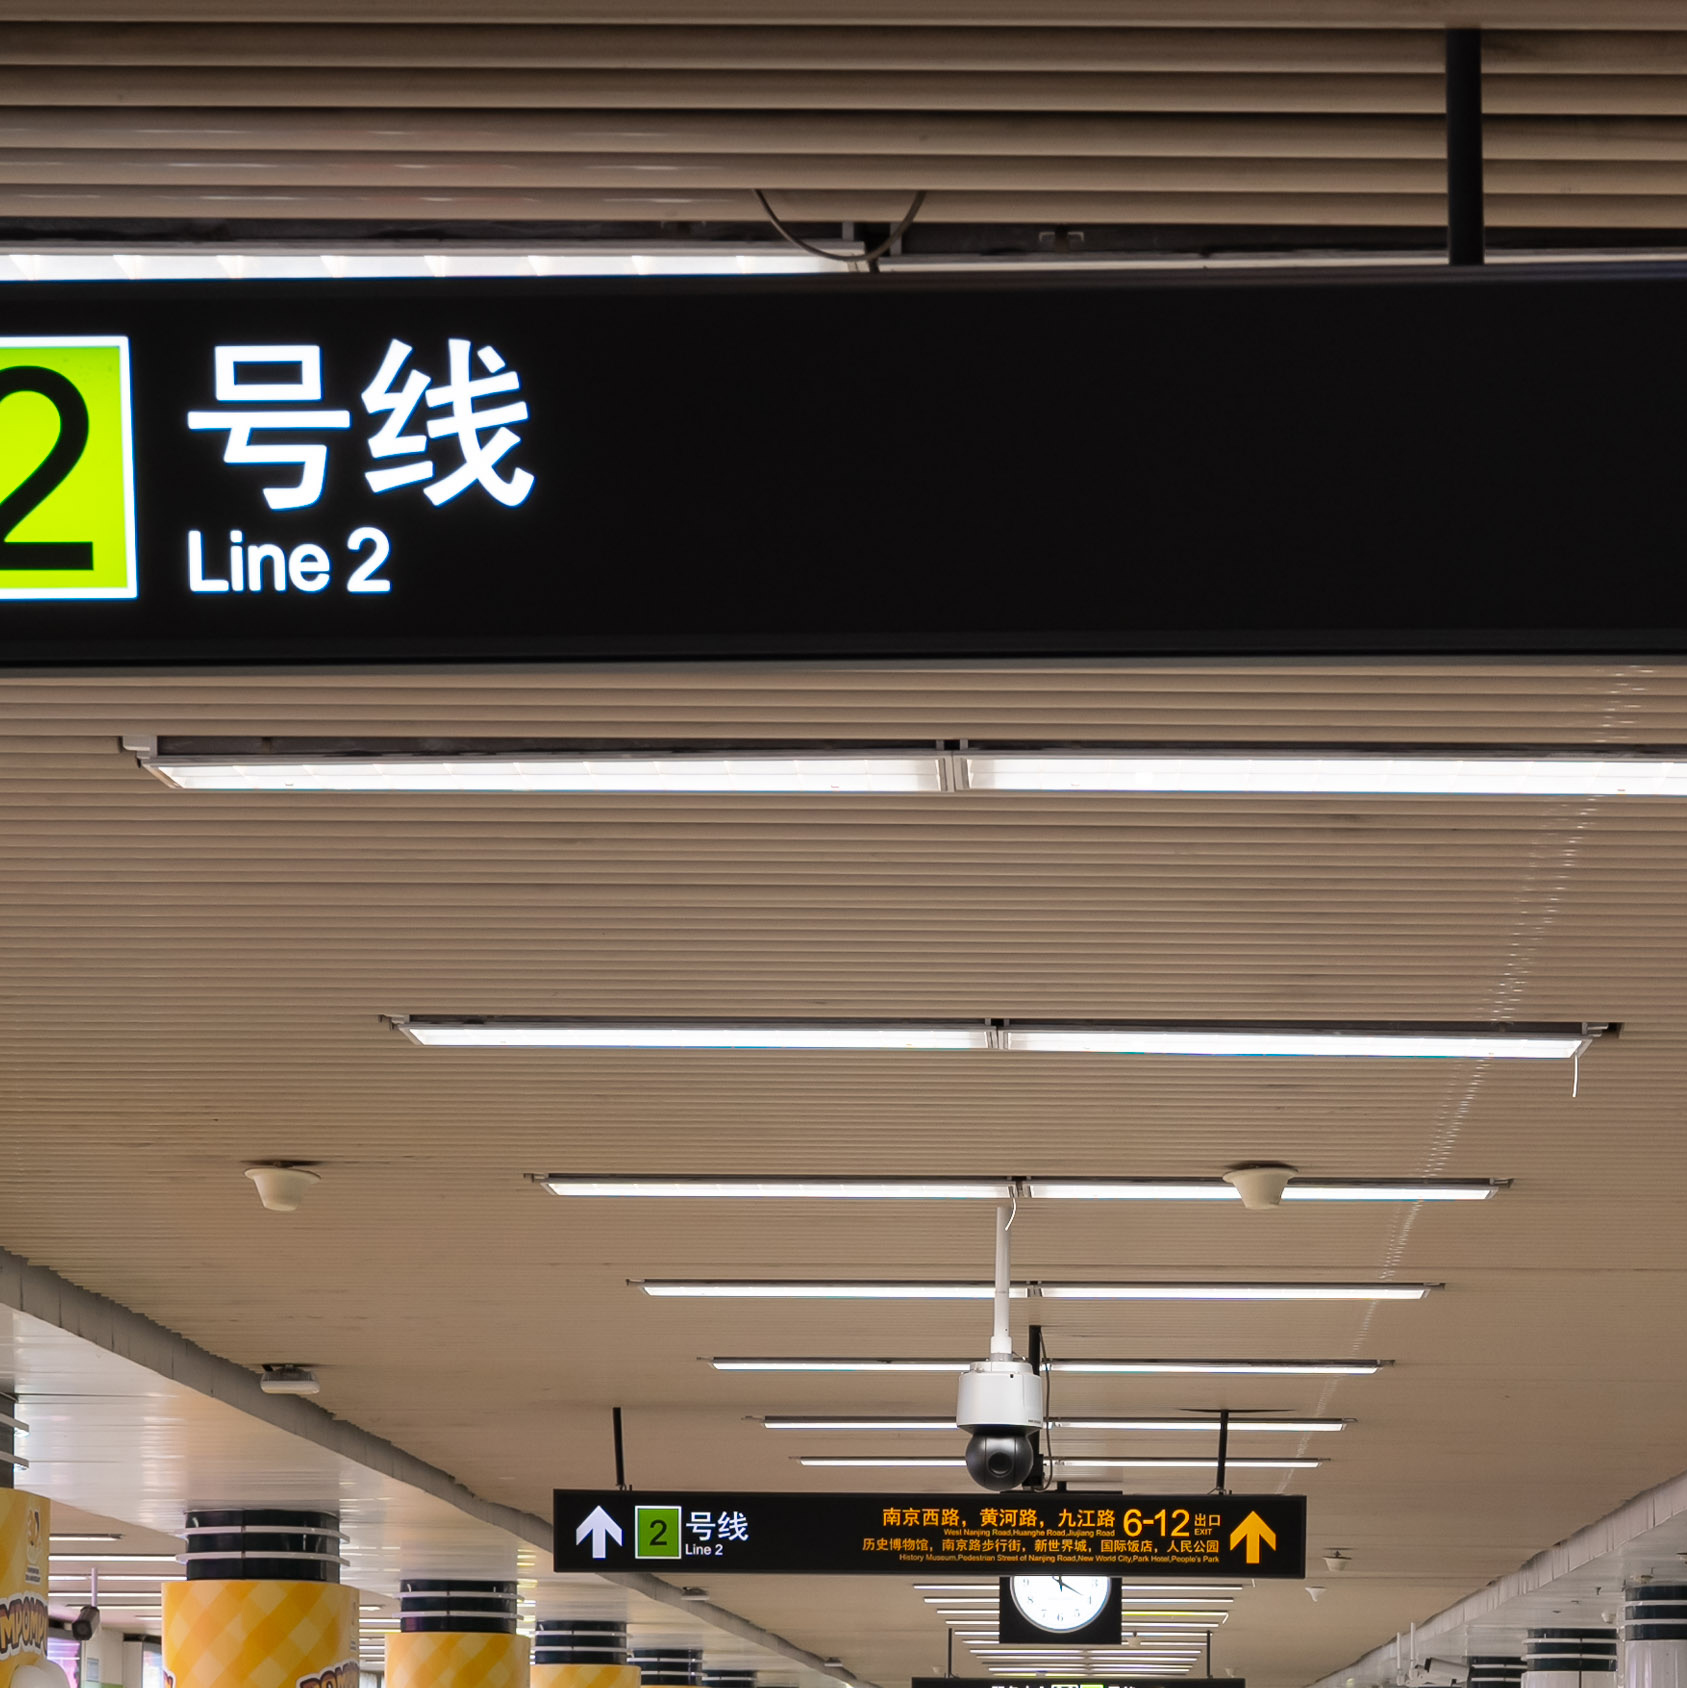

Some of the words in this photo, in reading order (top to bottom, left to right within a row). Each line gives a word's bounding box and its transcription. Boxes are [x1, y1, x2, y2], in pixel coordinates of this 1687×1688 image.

[188, 339, 534, 509] 号线
[188, 529, 330, 593] Line
[346, 527, 390, 593] 2
[649, 1519, 667, 1546] 2
[686, 1511, 749, 1541] 号线
[943, 1528, 962, 1536] West
[963, 1528, 990, 1537] Nanjing
[1123, 1508, 1190, 1537] 6-12
[1194, 1513, 1221, 1527] 出口
[1194, 1528, 1213, 1536] EXIT
[685, 1544, 712, 1555] Line
[715, 1544, 723, 1555] 2
[899, 1554, 924, 1563] History
[997, 1554, 1019, 1562] Street
[1019, 1554, 1027, 1562] of
[1028, 1554, 1056, 1563] Nanjing
[1203, 1555, 1219, 1563] Park
